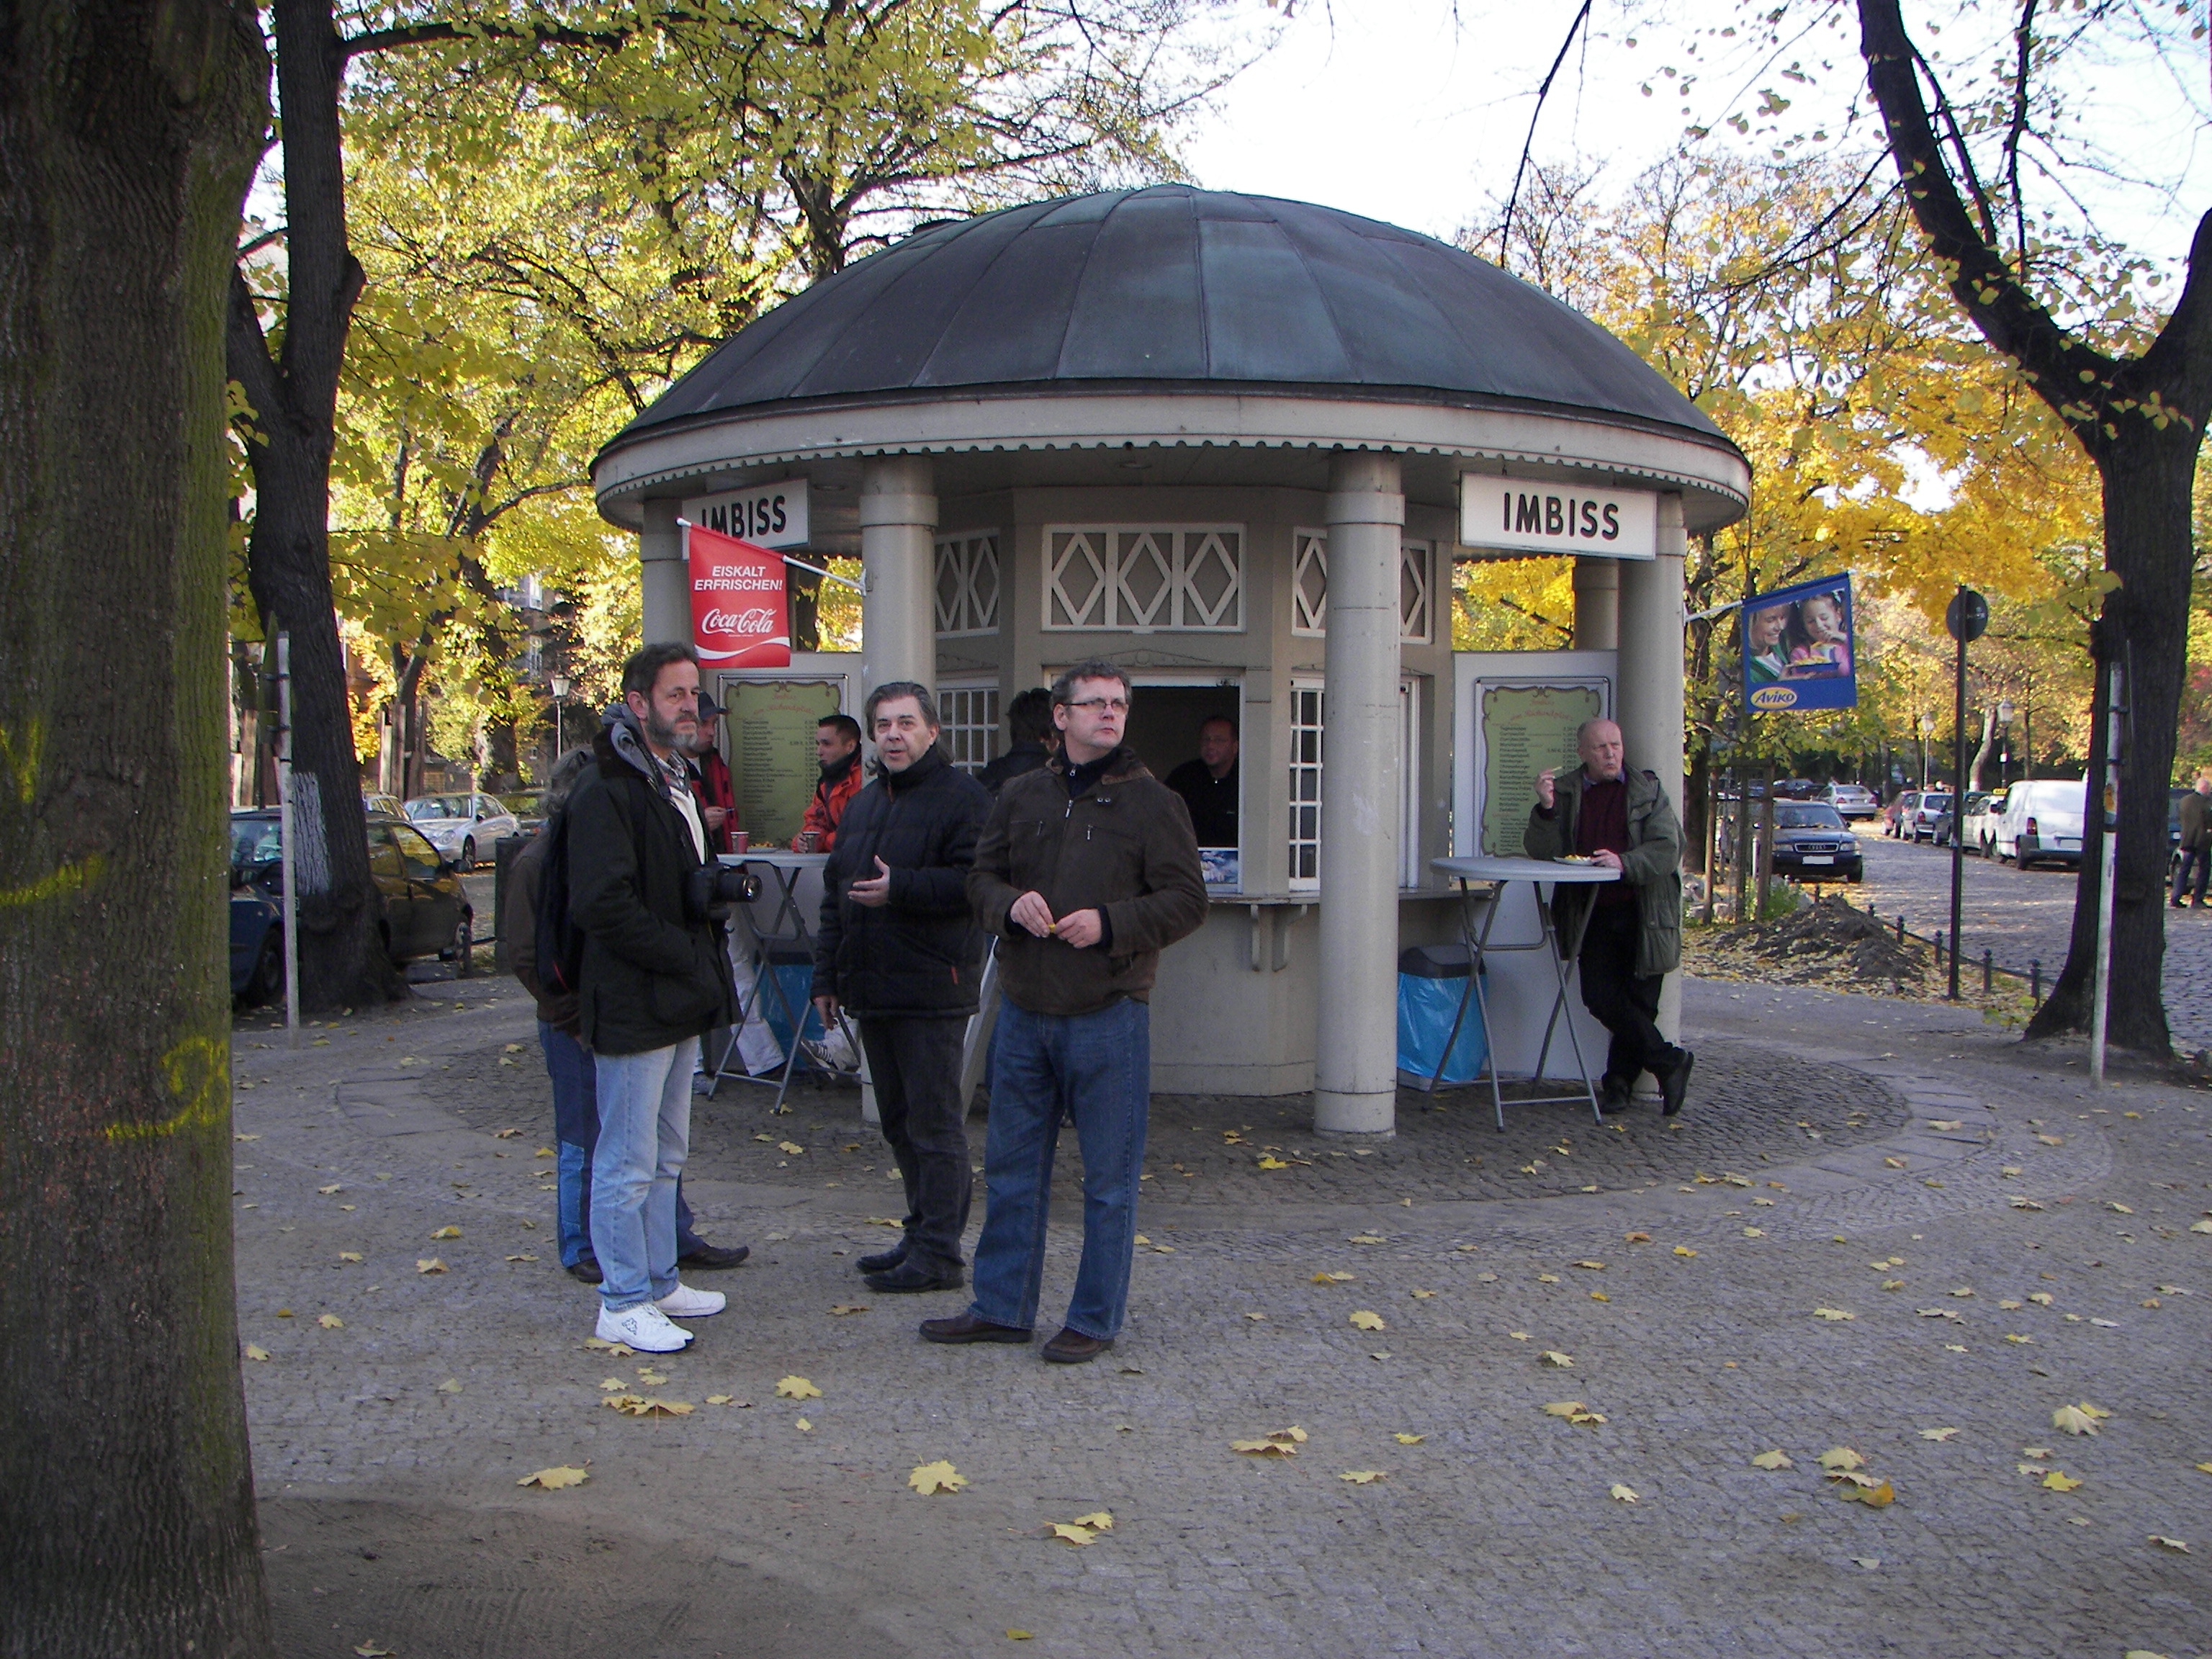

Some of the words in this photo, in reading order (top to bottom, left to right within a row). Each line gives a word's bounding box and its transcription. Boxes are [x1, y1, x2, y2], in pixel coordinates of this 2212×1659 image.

[702, 495, 786, 539] IMBISS
[1503, 492, 1619, 541] IMBISS
[712, 565, 766, 577] EISKALT
[694, 579, 783, 590] ERFRISCHEN!
[701, 608, 777, 634] Coca-Cola
[1755, 691, 1794, 703] Aviko
